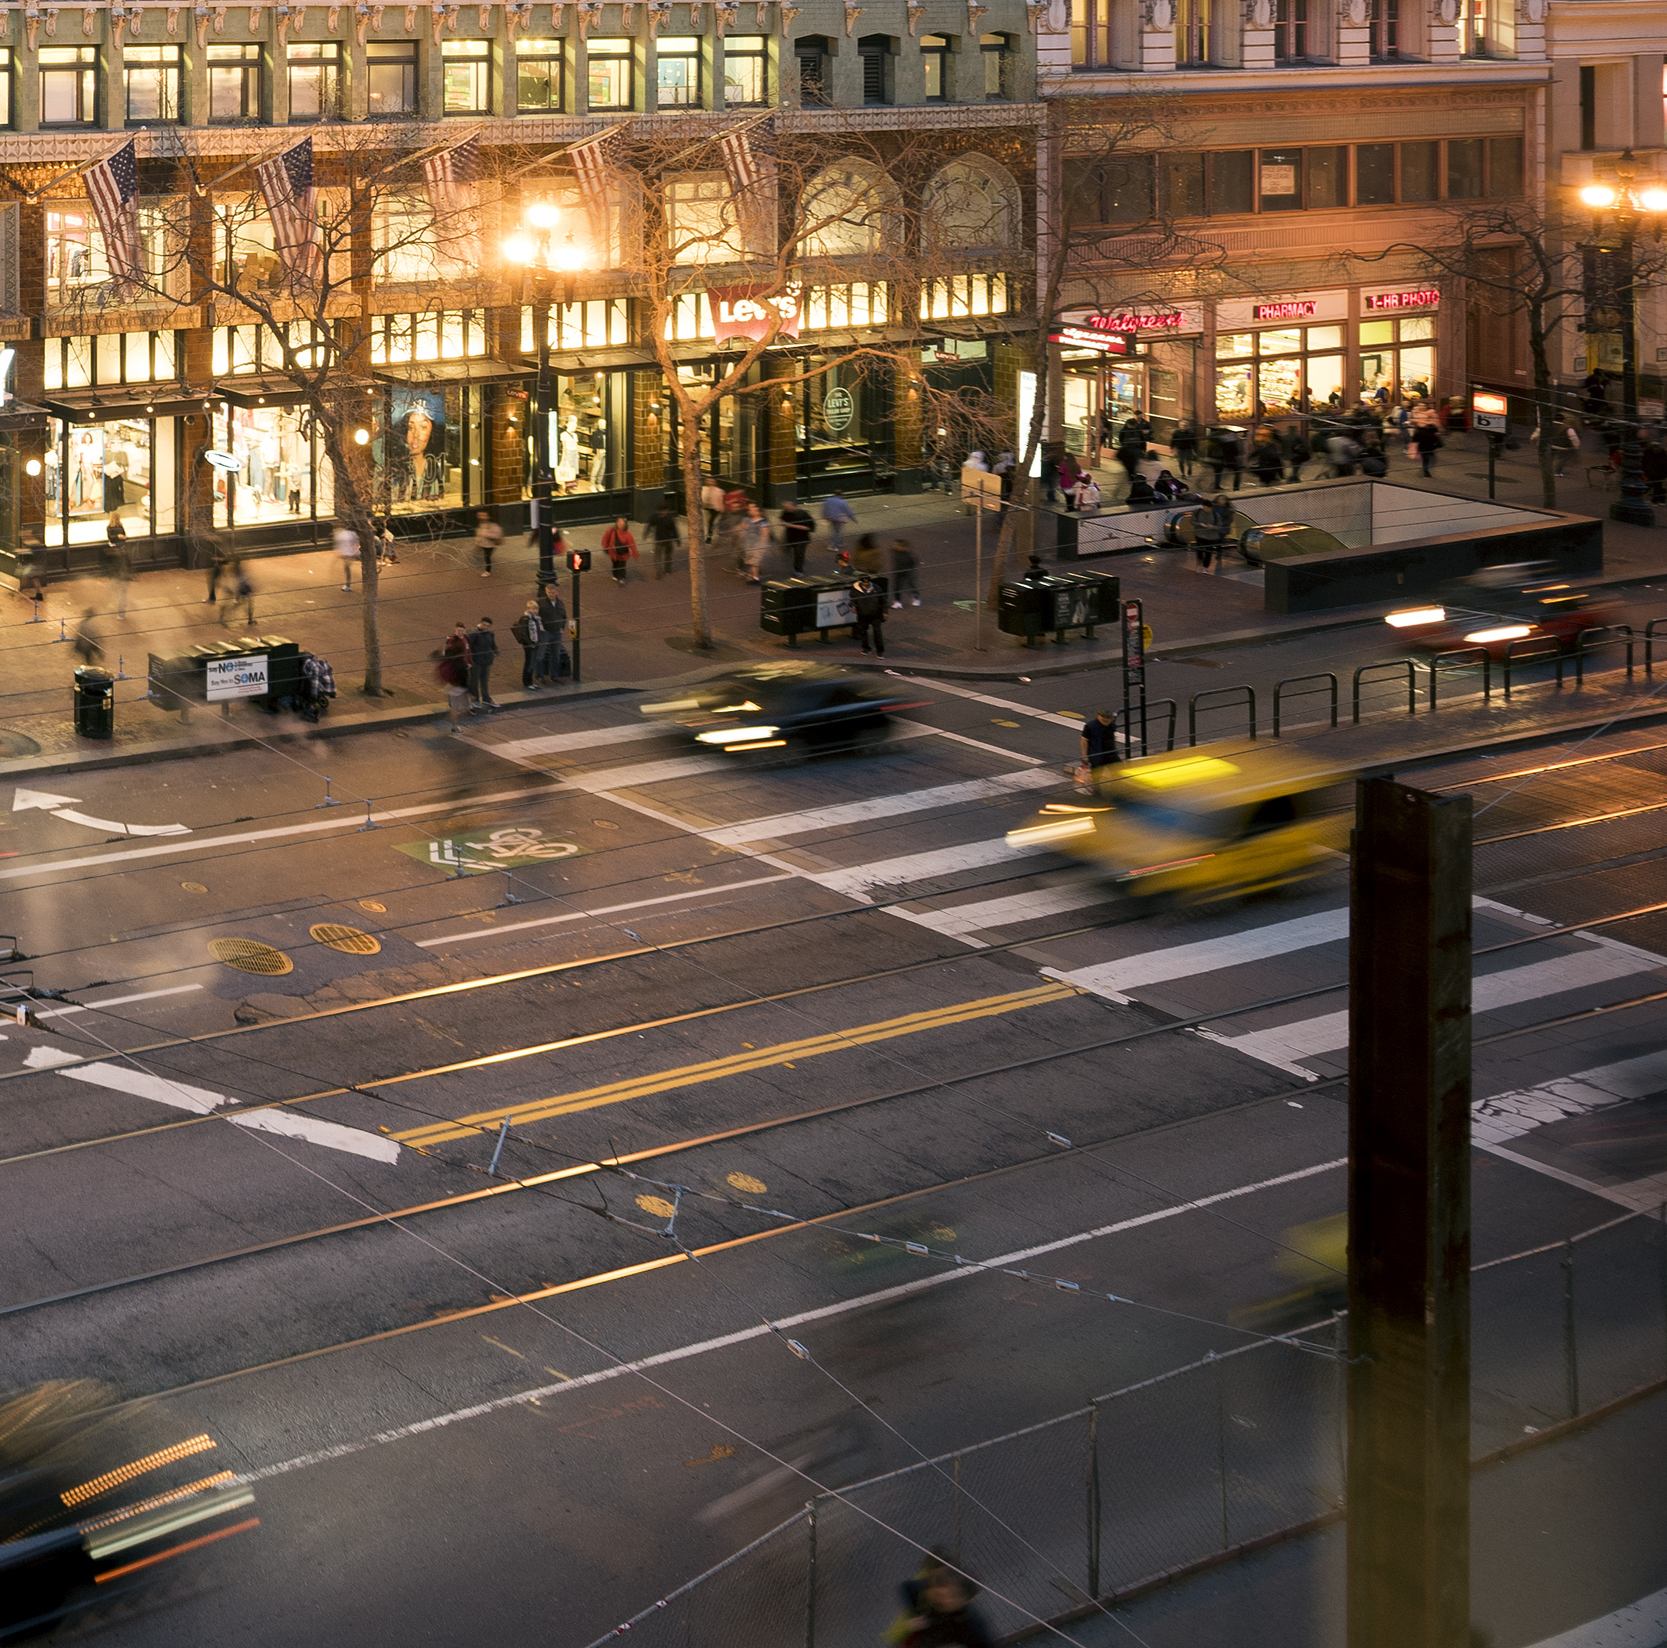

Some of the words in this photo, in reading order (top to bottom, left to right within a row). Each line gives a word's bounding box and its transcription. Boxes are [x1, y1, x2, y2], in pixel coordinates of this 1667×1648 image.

[1370, 294, 1399, 309] 1-HR
[1401, 290, 1440, 307] PHOTO
[1259, 301, 1319, 320] PHARMACY
[1090, 312, 1188, 333] Walgreens
